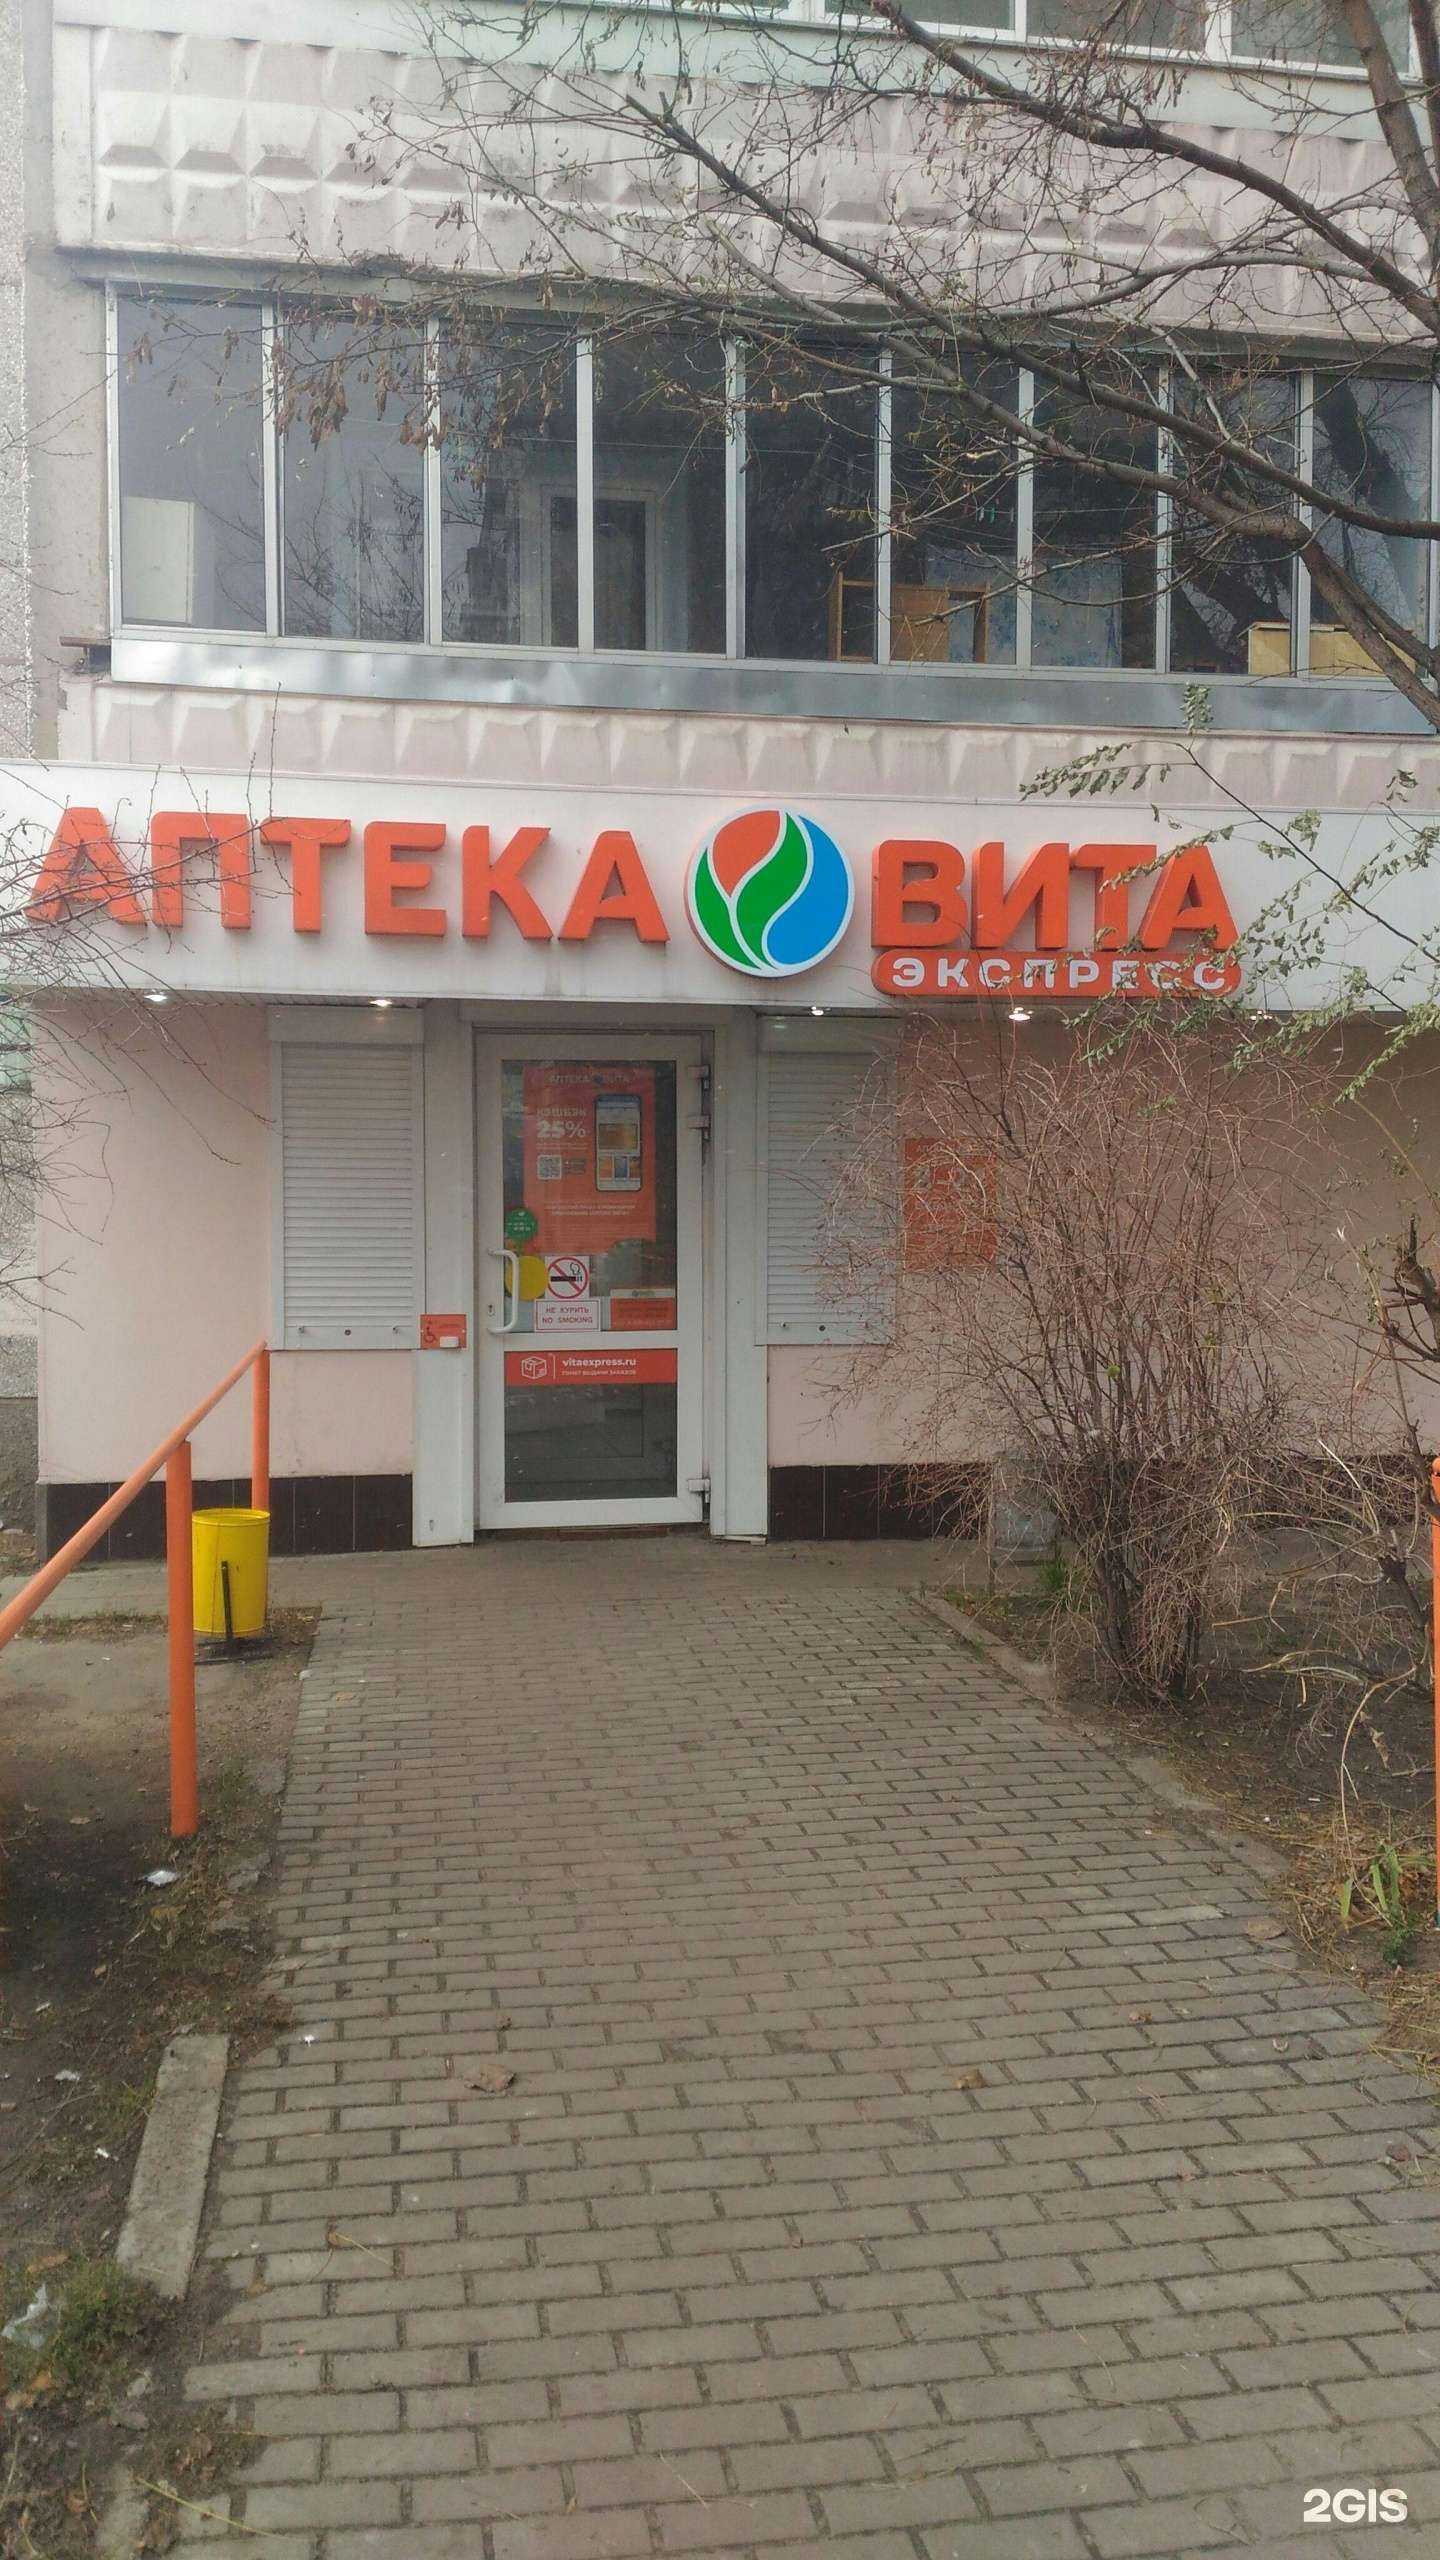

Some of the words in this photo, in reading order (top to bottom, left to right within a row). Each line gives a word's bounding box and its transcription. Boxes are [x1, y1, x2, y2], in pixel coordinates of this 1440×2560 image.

[22, 806, 671, 943] АПТЕКА
[871, 838, 1240, 950] ВИТА
[536, 1120, 586, 1138] 25%
[560, 1306, 589, 1314] КУРИТЬ
[558, 1316, 593, 1324] SMOKING
[562, 1357, 637, 1369] vitaexpress.ru
